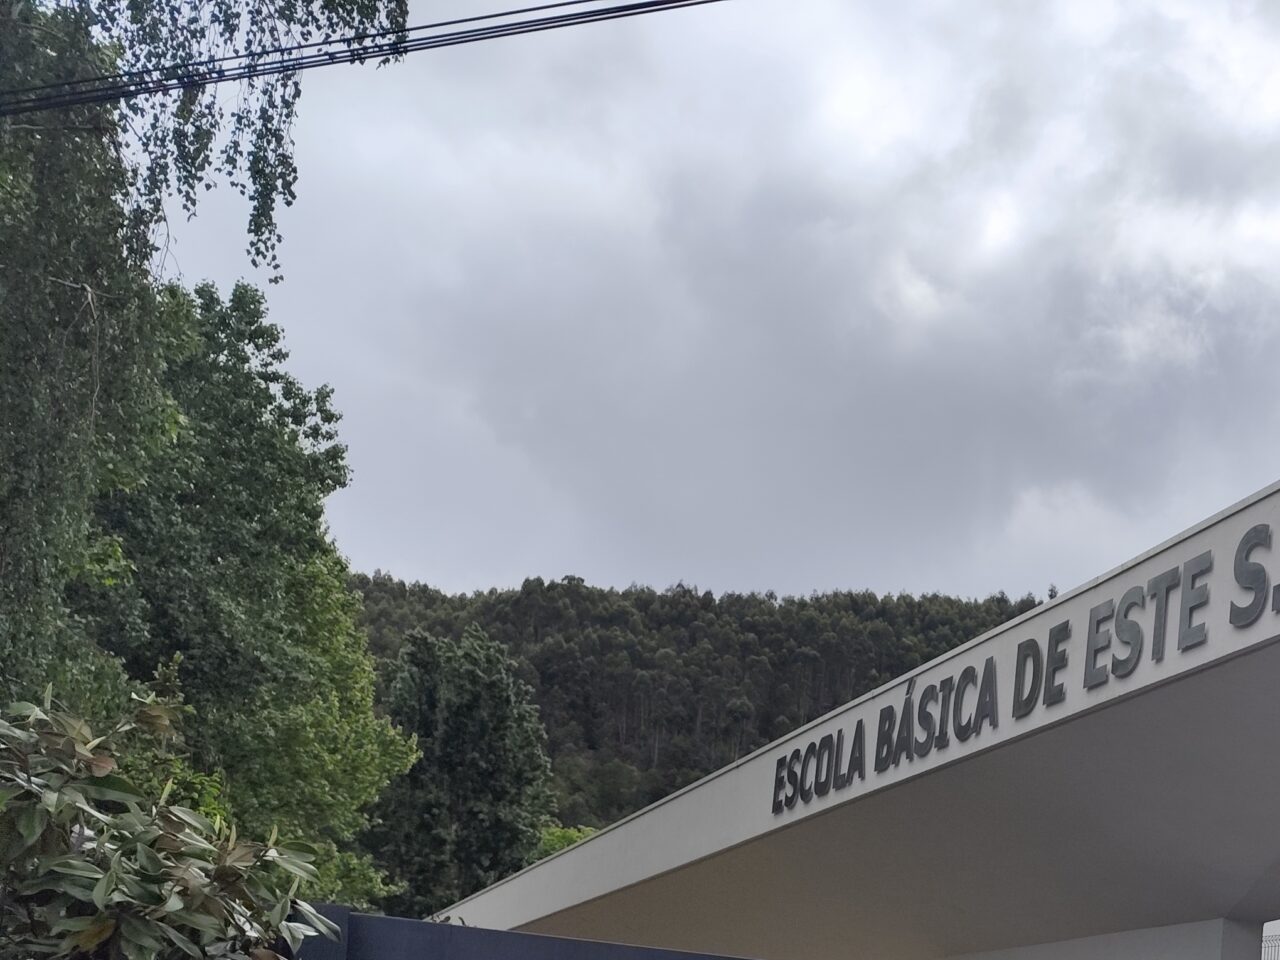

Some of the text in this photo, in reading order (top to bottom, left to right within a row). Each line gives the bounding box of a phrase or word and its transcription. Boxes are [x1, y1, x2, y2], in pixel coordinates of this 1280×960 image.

[772, 719, 865, 815] ESCOLA
[874, 656, 998, 774] BÁSICA
[1012, 619, 1070, 720] DE
[1083, 549, 1213, 692] ESTE
